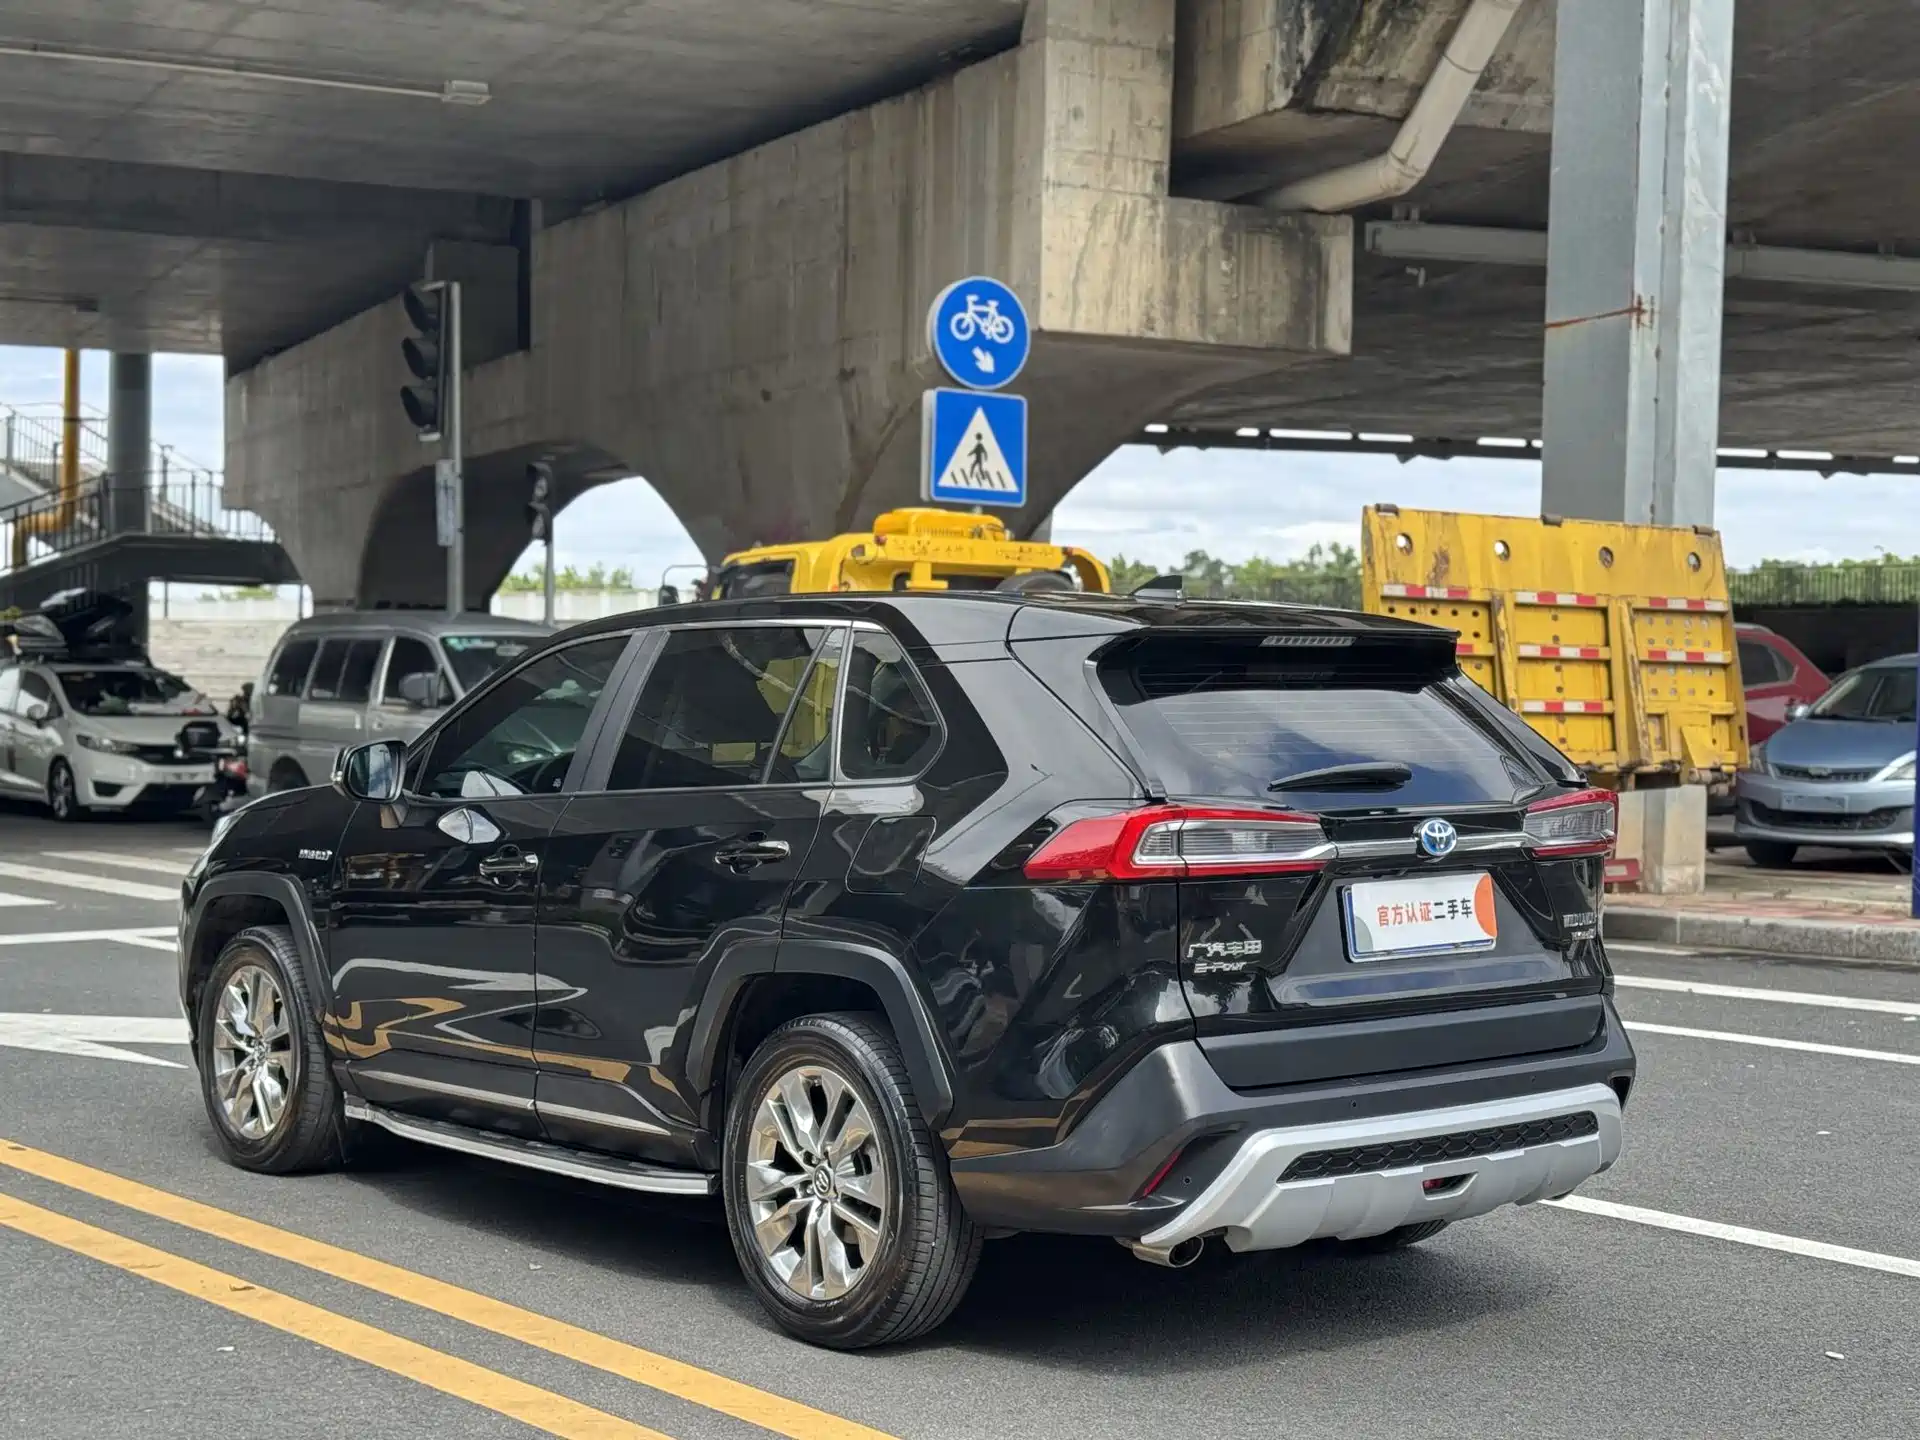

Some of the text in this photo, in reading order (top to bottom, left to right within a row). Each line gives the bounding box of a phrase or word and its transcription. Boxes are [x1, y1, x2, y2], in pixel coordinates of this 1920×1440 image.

[1377, 898, 1473, 927] 官方认证二手车
[1187, 940, 1262, 958] 广汽丰田
